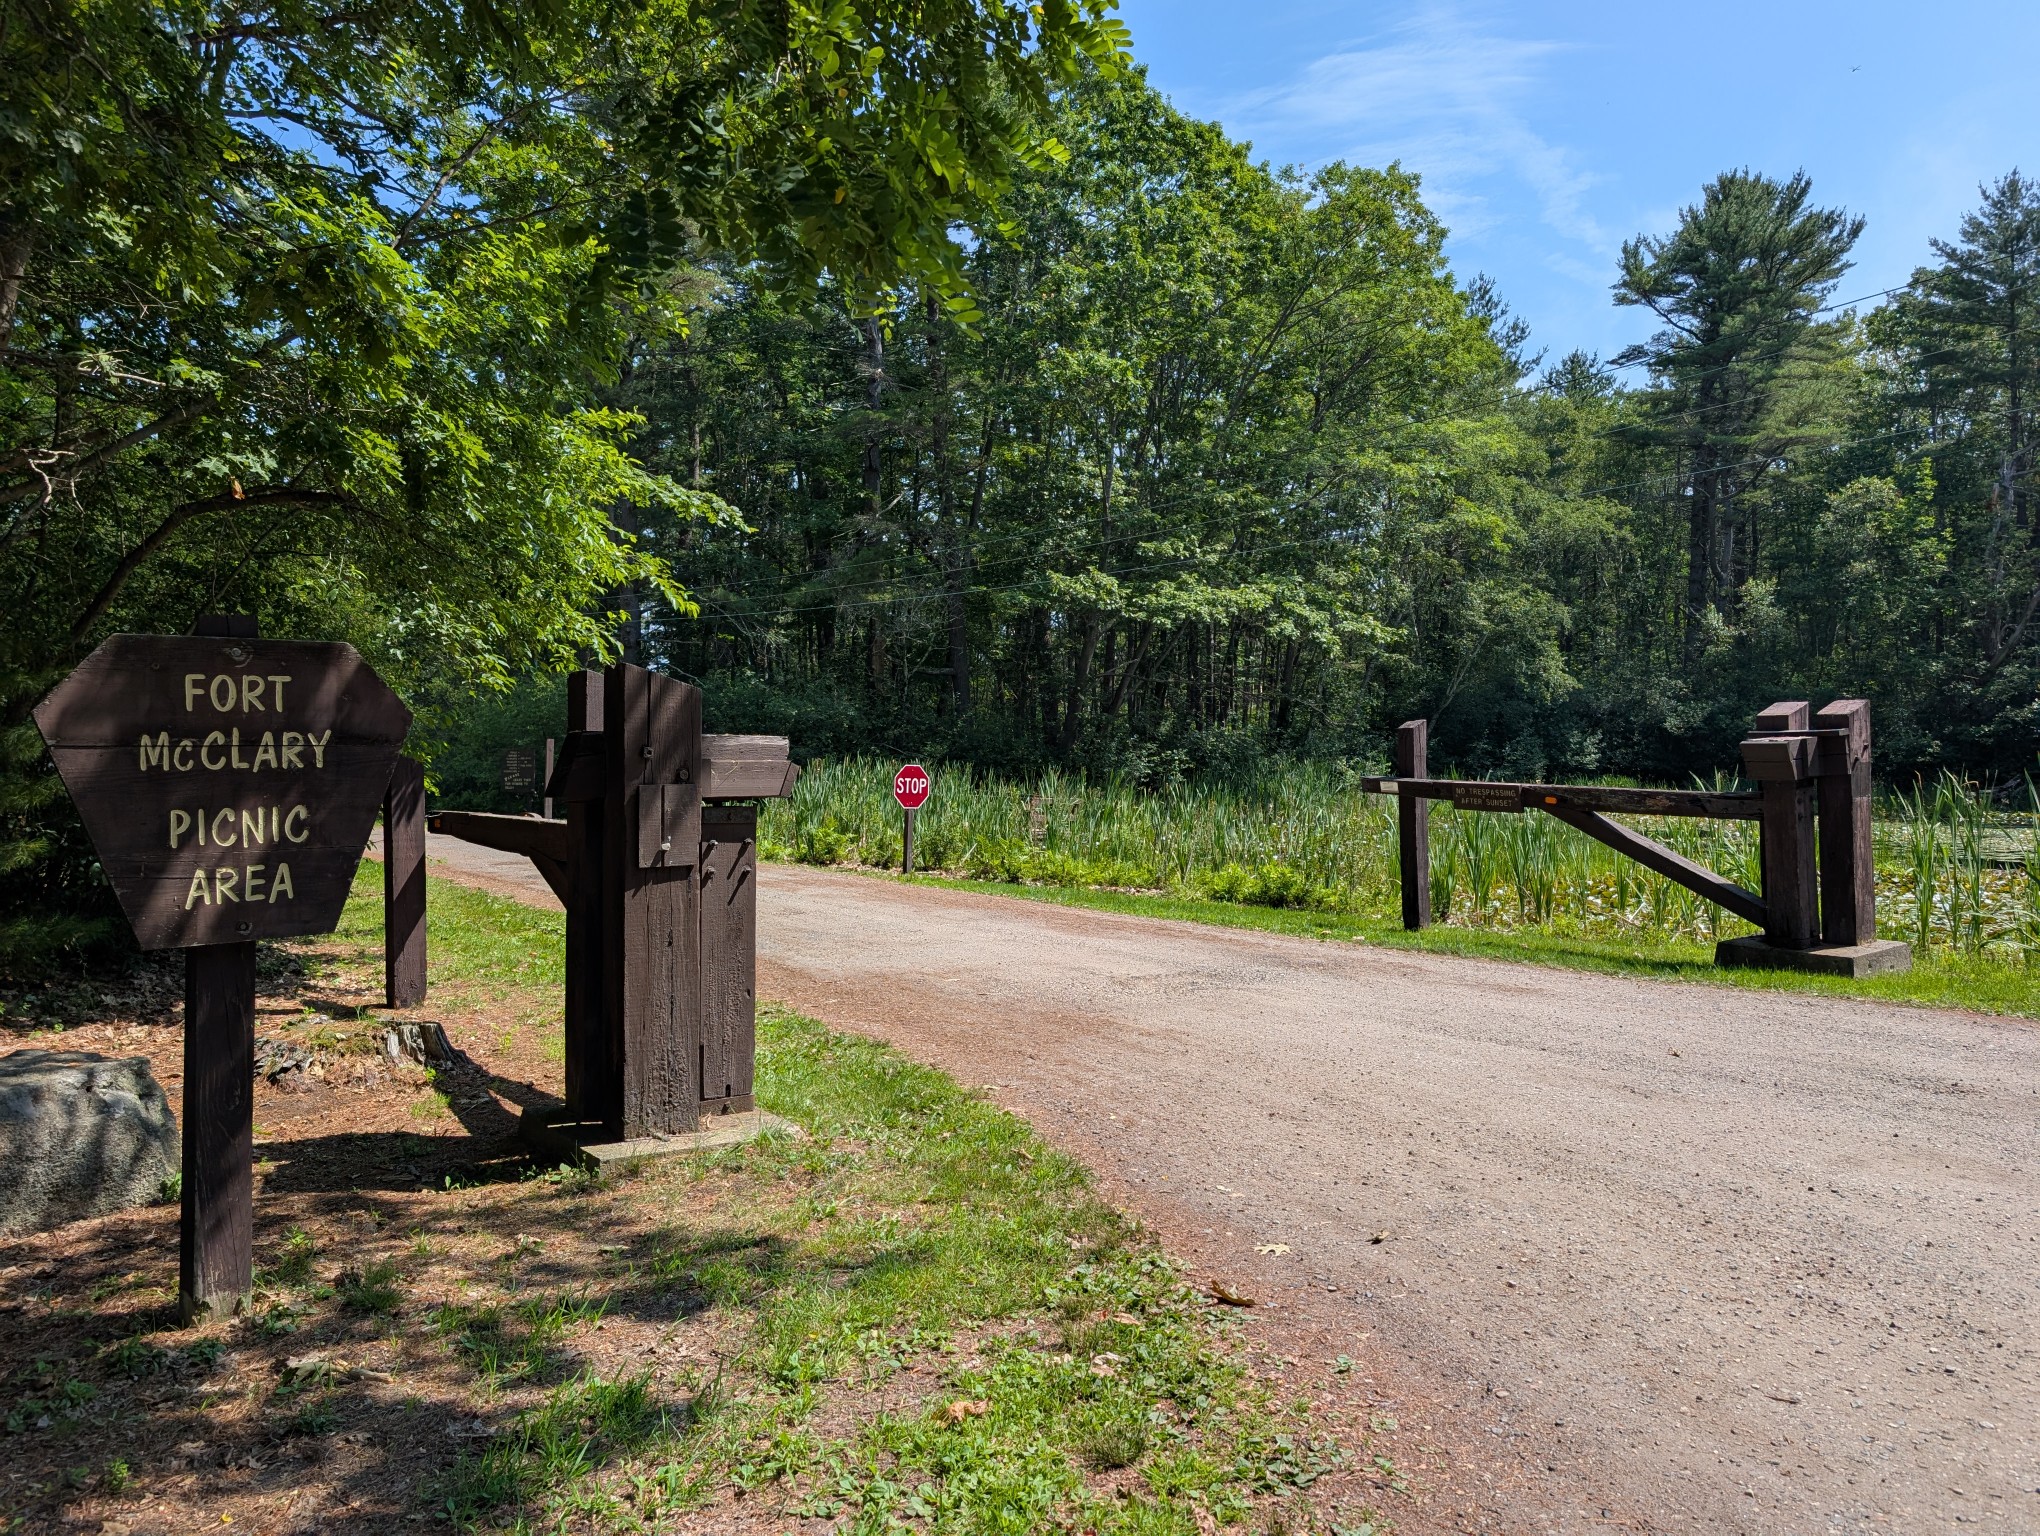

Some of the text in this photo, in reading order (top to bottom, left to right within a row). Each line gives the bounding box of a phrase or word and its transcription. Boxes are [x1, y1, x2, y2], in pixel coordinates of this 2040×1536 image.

[184, 673, 292, 713] FORT
[139, 727, 332, 773] McCLARY
[896, 777, 927, 794] STOP
[1455, 787, 1517, 797] NO TRESPASSING
[1461, 797, 1512, 807] AFTER SUNSET
[169, 804, 310, 849] PICNIC
[184, 862, 294, 911] AREA
